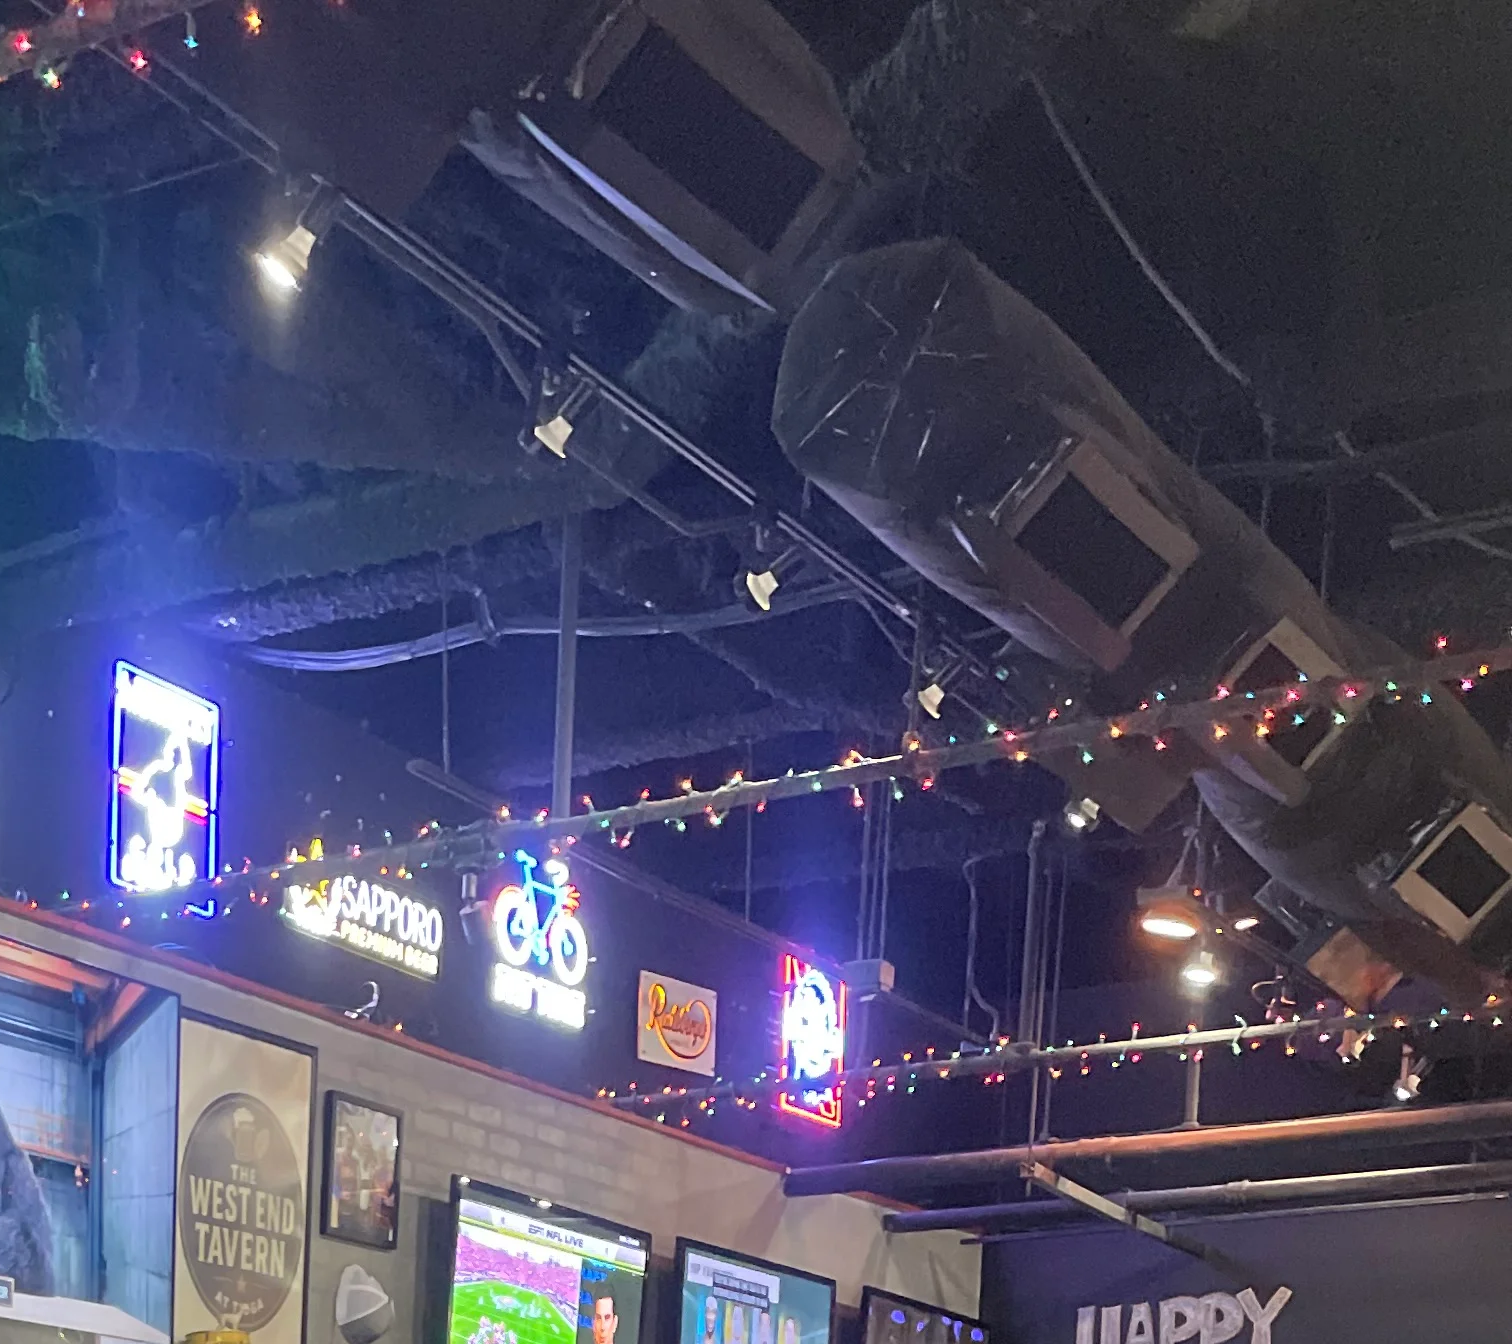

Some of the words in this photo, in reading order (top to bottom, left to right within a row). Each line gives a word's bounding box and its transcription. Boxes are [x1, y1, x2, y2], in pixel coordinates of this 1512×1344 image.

[340, 875, 443, 952] SAPPORO
[229, 1163, 258, 1186] THE
[189, 1174, 250, 1225] WEST
[253, 1194, 296, 1237] END
[194, 1222, 286, 1281] TAVERN
